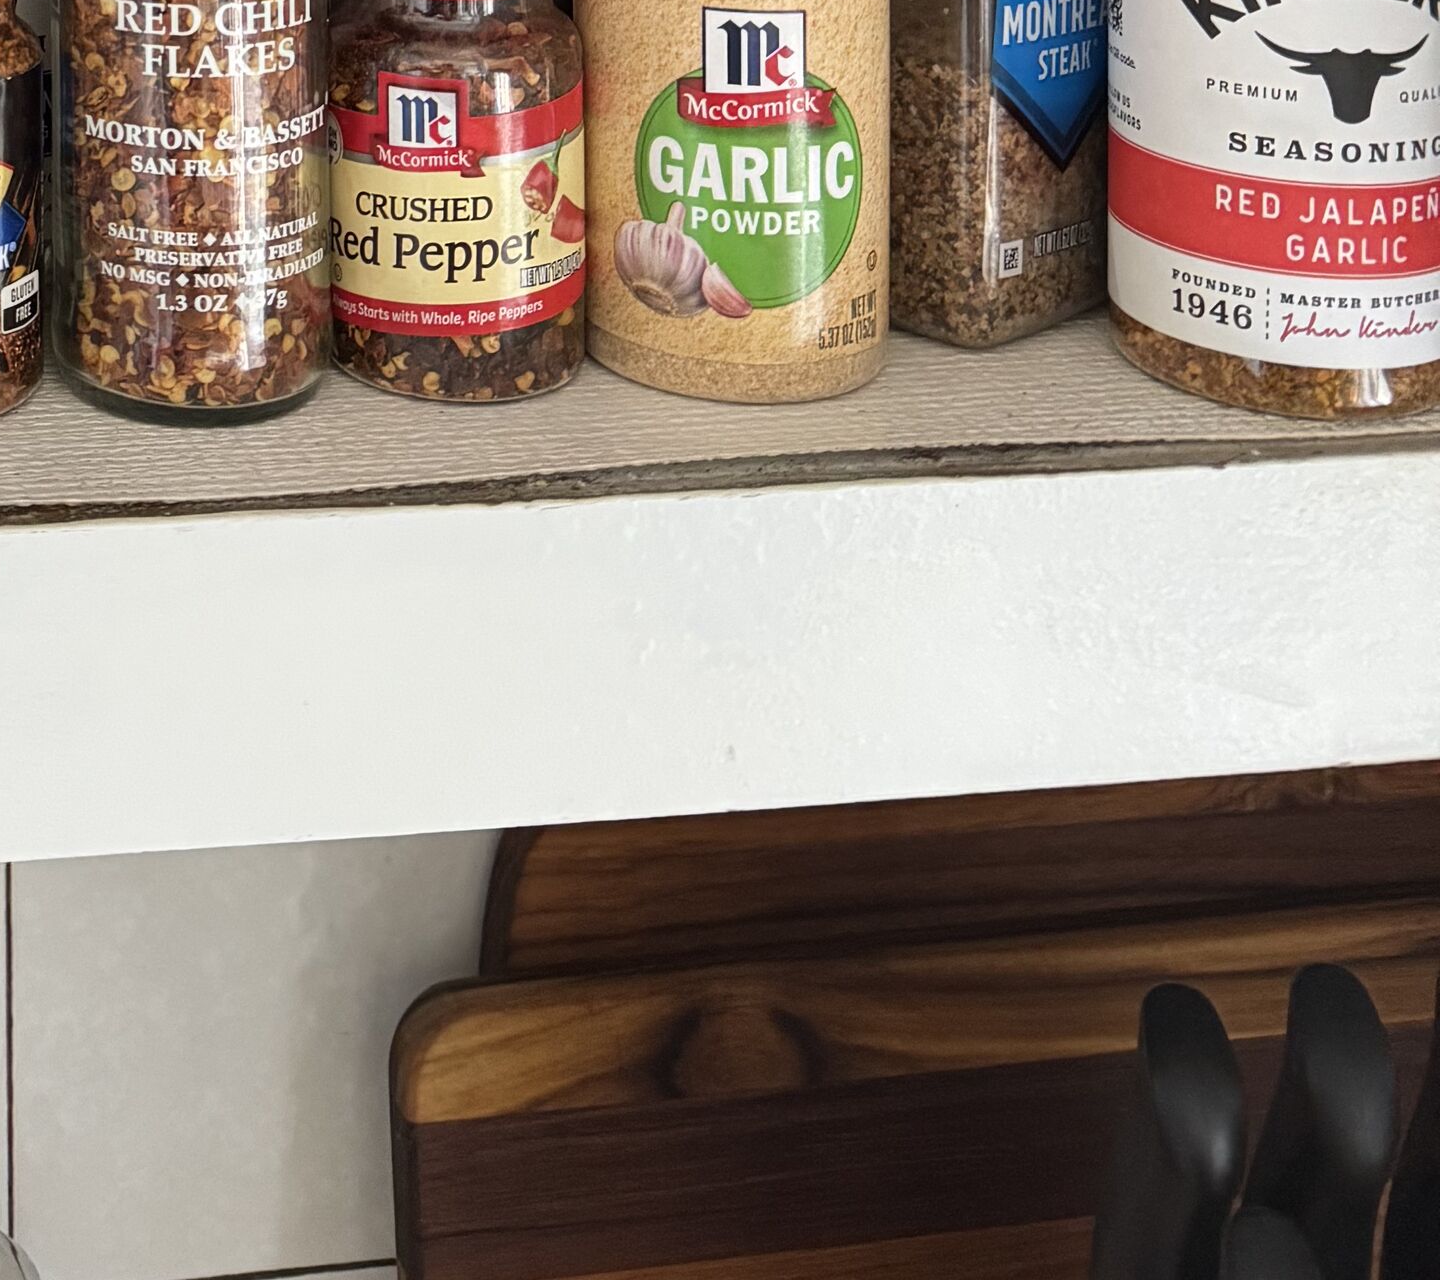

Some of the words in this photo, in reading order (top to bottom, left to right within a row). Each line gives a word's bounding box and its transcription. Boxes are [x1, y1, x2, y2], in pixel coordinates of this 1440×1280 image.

[142, 37, 296, 79] FLAKES
[1037, 42, 1092, 82] STEAK
[1206, 77, 1299, 104] PREMIUM
[684, 93, 818, 122] McCormick
[85, 115, 204, 151] MORTON
[214, 127, 237, 151] &
[243, 107, 327, 148] BASSETT
[130, 155, 179, 176] SAN
[183, 147, 304, 179] FRANCISCO
[376, 145, 469, 168] McCormick
[648, 134, 855, 204] GARLIC
[356, 191, 493, 223] CRUSHED
[1215, 183, 1281, 221] RED
[1299, 186, 1440, 226] JALAPEÑ
[107, 222, 149, 243] SALT
[153, 230, 198, 247] FREE
[259, 212, 319, 242] NATURAL
[691, 206, 820, 236] POWDER
[134, 245, 265, 267] PRESERVATIVE
[269, 239, 304, 261] FREE
[330, 216, 380, 268] Red
[393, 227, 539, 284] Pepper
[1285, 235, 1408, 266] GARLIC
[11, 279, 36, 303] GLUTEN
[129, 267, 171, 286] MSG
[1170, 266, 1257, 300] FOUNDED
[1279, 291, 1362, 310] MASTER
[358, 302, 390, 322] Starts
[391, 309, 418, 324] with
[421, 309, 465, 328] Whole,
[468, 306, 495, 325] Ripe
[498, 298, 543, 322] Peppers
[1171, 288, 1254, 330] 1946
[819, 326, 840, 349] 5.37
